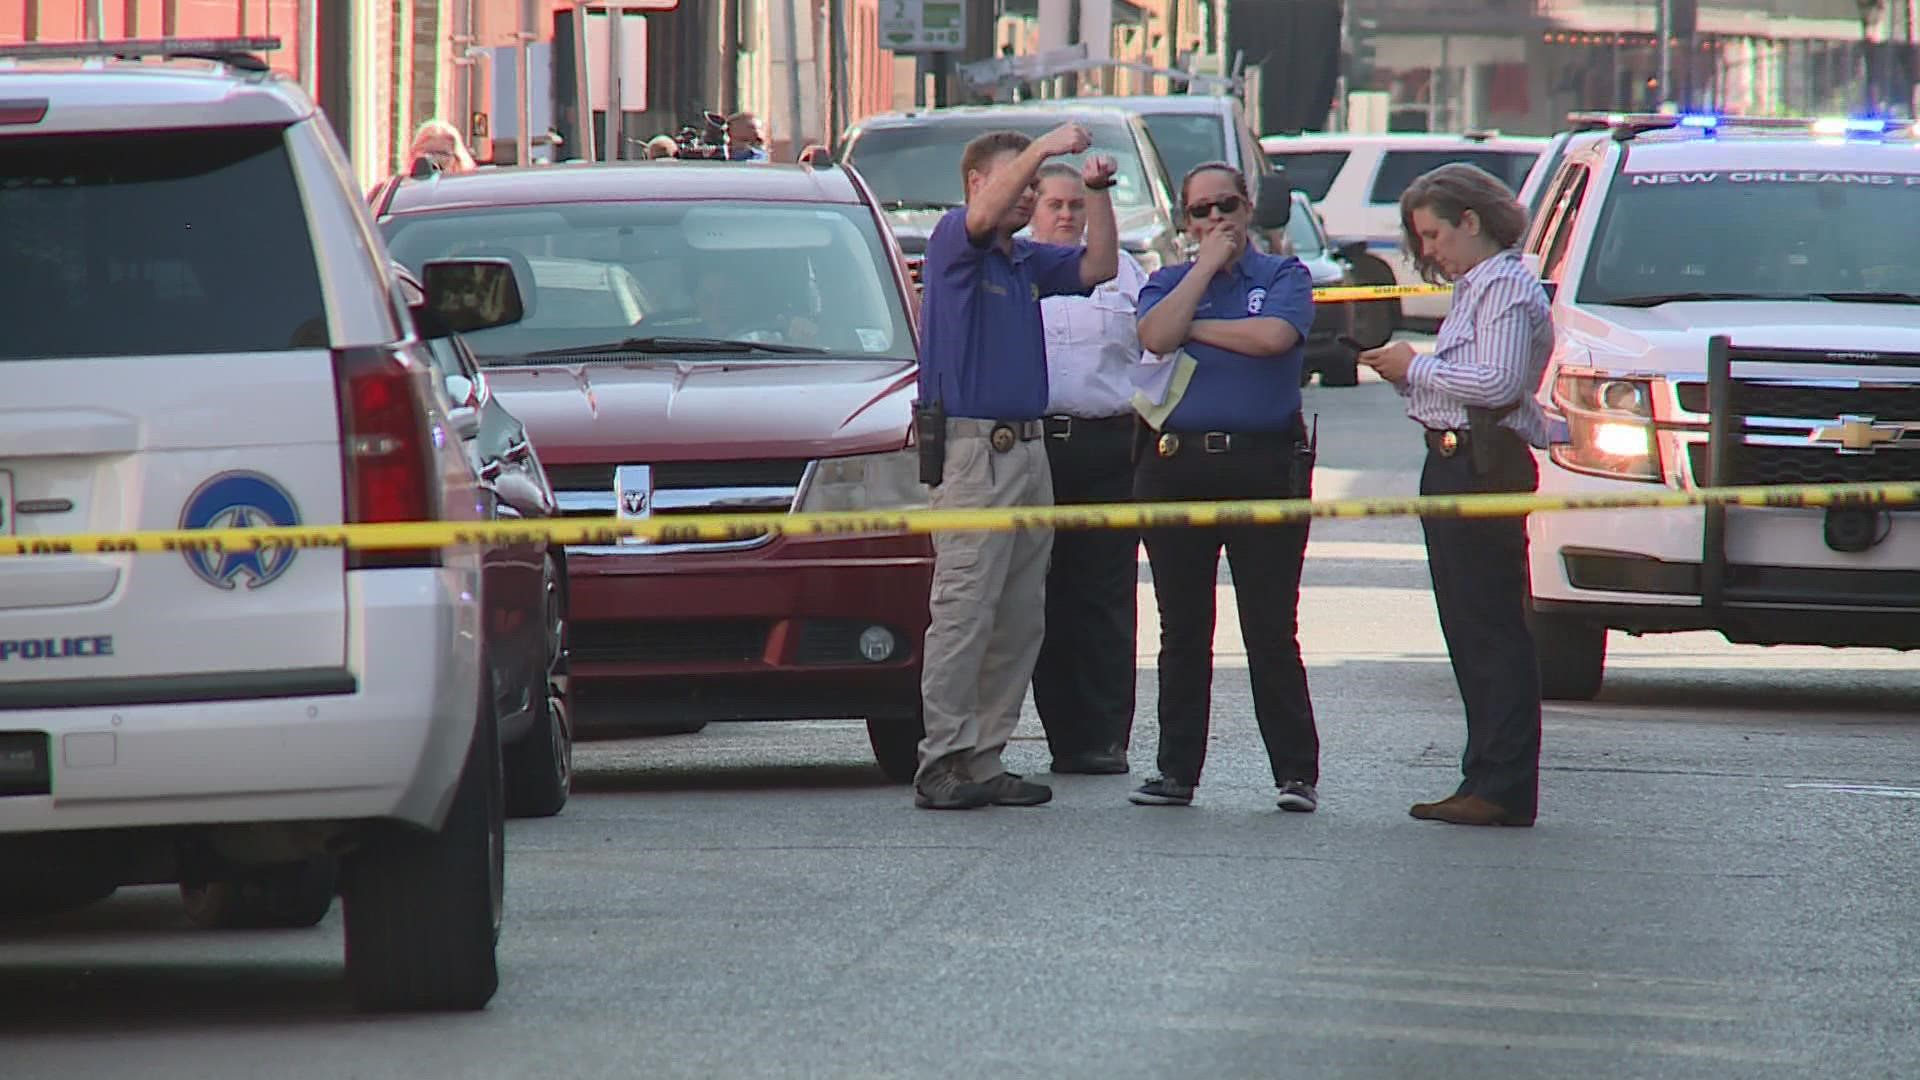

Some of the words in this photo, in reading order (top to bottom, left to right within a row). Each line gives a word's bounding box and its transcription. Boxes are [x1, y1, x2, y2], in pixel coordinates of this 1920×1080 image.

[1632, 172, 1717, 184] NEW
[1729, 172, 1893, 185] ORLEANS
[0, 635, 114, 659] POLICE
